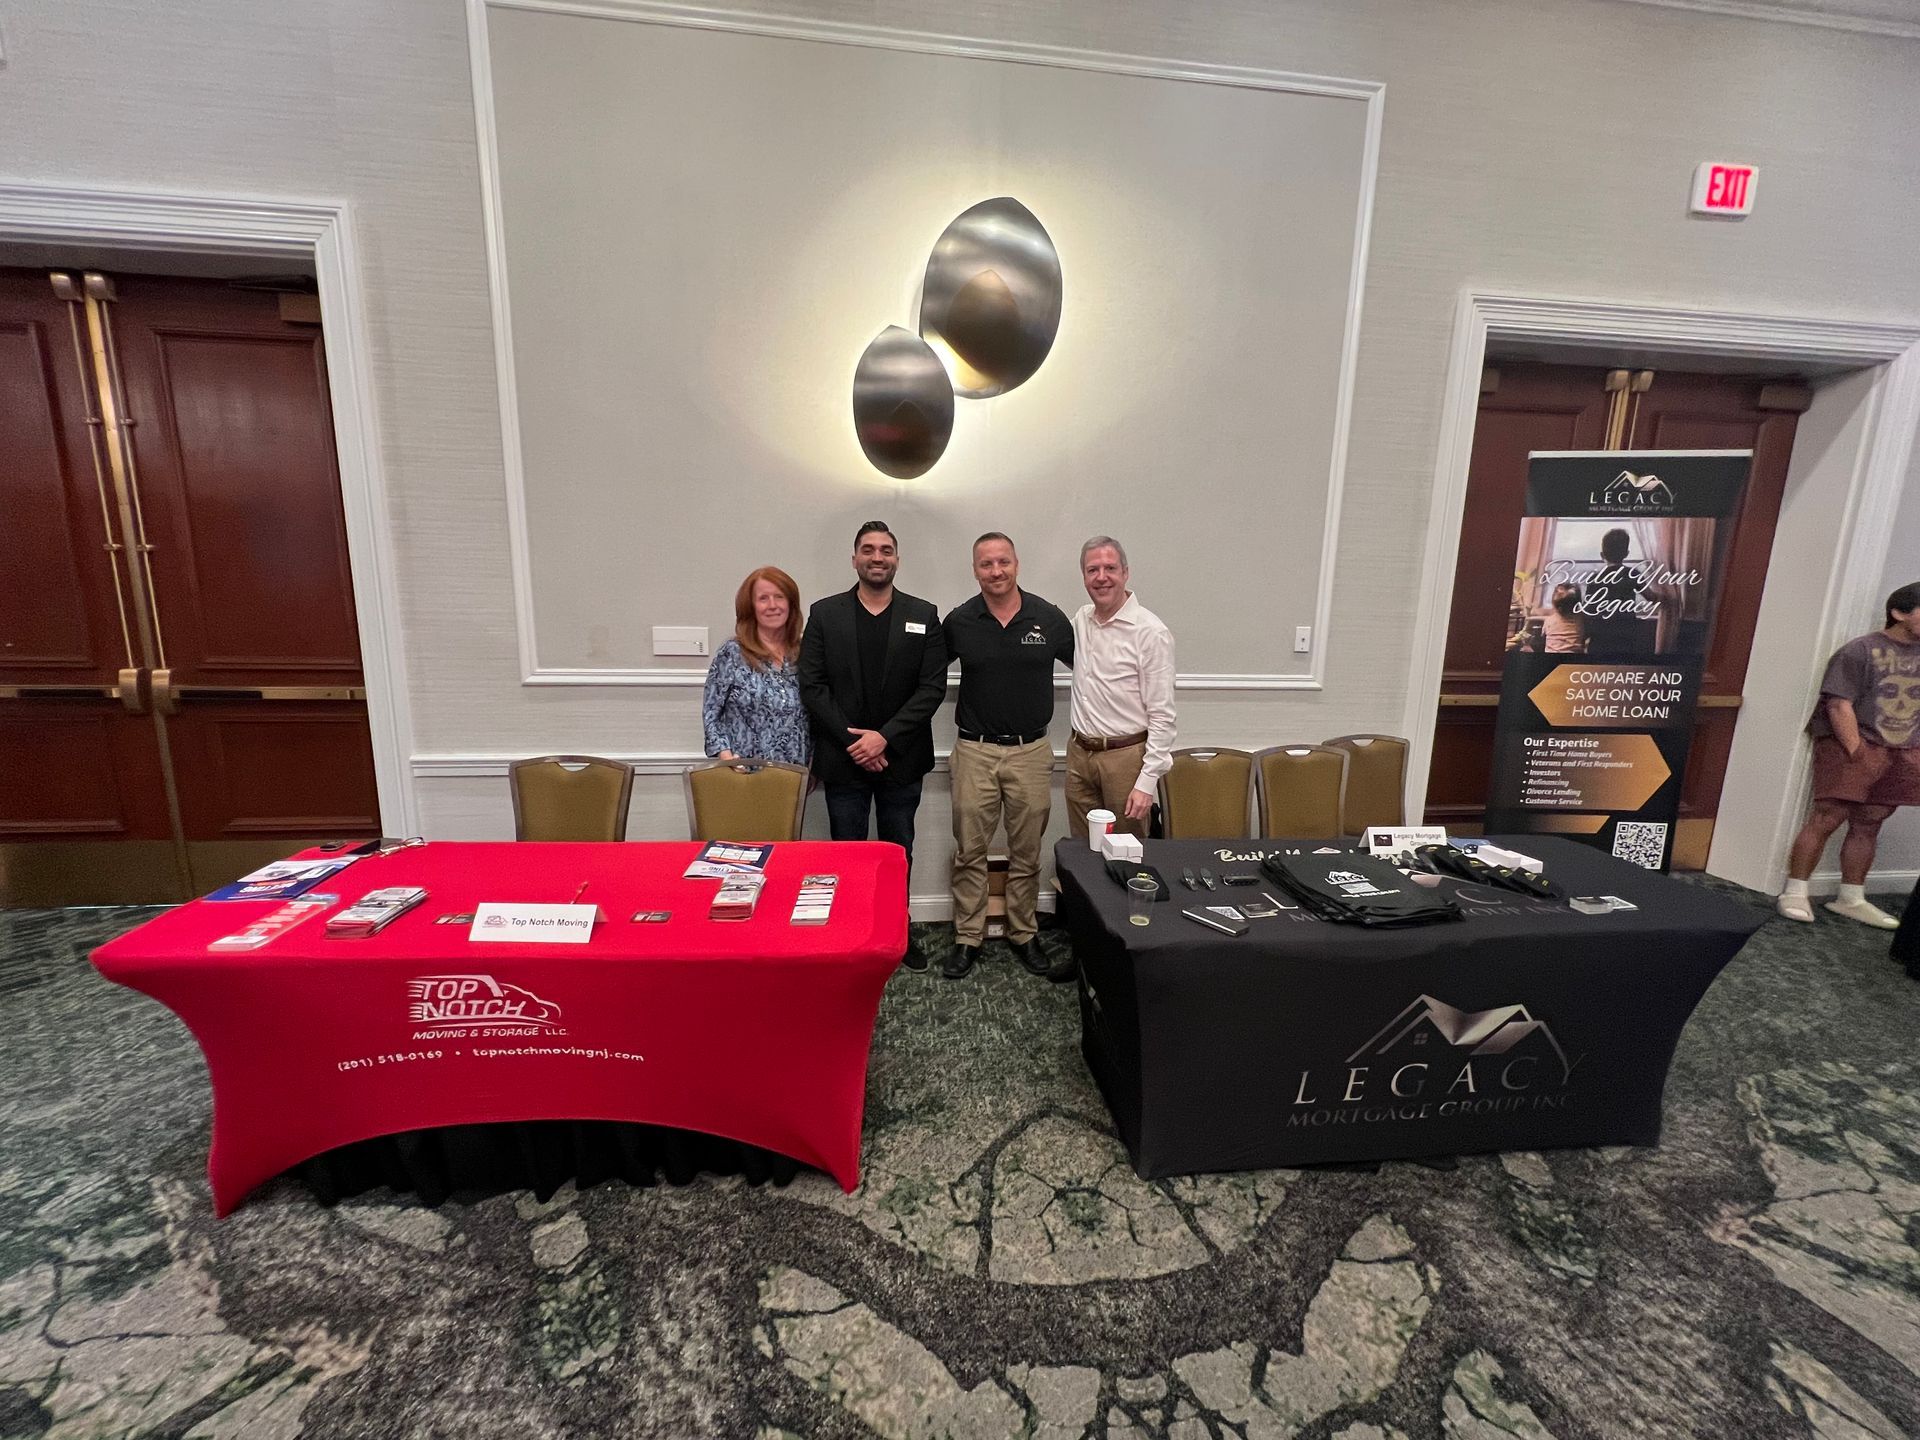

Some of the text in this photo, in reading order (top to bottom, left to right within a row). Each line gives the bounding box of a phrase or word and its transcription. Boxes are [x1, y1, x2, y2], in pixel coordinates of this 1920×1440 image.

[1706, 166, 1751, 209] EXIT
[1589, 491, 1678, 504] LEGACY
[1539, 559, 1703, 593] Build Your
[1573, 587, 1662, 620] Legacy
[1569, 671, 1683, 685] COMPARE AND
[1565, 688, 1682, 702] SAVE ON YOUR
[1571, 705, 1669, 719] HOME LOAN!
[1523, 737, 1600, 749] Our Expertise
[1527, 779, 1570, 787] Refinancing
[1552, 789, 1582, 797] Lending
[511, 917, 527, 926] Top
[528, 918, 555, 926] Notch
[556, 919, 589, 928] Moving
[422, 981, 479, 1000] TOP
[421, 1000, 527, 1020] NOTCH
[412, 1028, 467, 1040] MOVING
[469, 1028, 479, 1038] &
[482, 1026, 539, 1037] STORAGE
[337, 1050, 443, 1072] (201) 518-0169
[472, 1045, 645, 1062] topnotchmovingnj.com
[1293, 1054, 1588, 1105] LEGACY
[1286, 1102, 1432, 1128] MORTGAGE
[1438, 1095, 1527, 1117] GROUP
